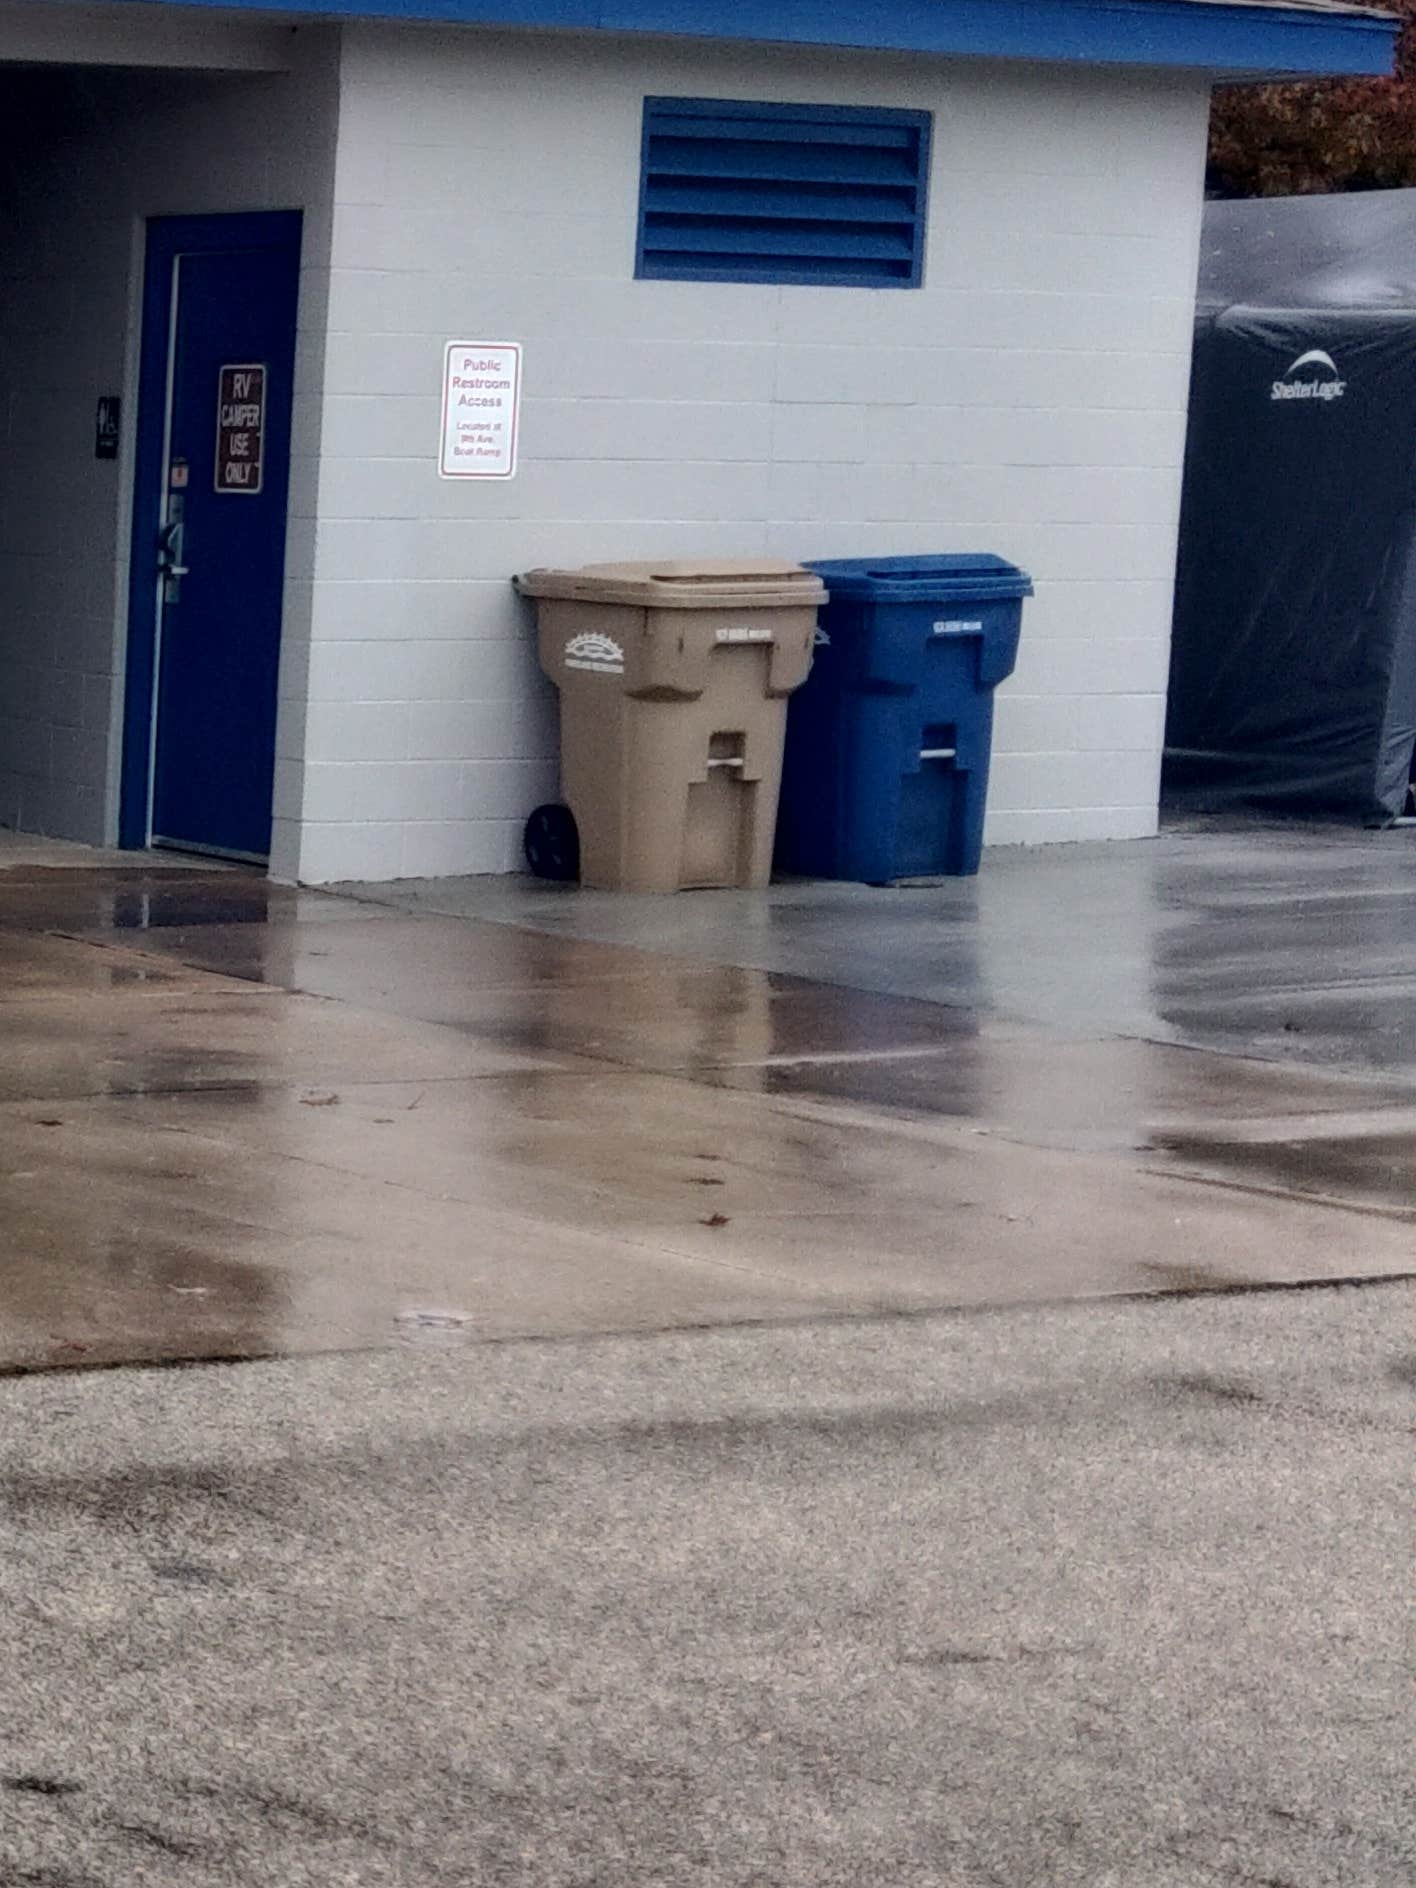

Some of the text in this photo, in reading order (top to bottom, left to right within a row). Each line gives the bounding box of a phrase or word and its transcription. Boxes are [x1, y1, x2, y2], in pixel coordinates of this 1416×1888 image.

[463, 358, 502, 371] Public
[233, 373, 252, 399] RV
[452, 376, 511, 389] Restroom
[1270, 379, 1347, 401] ShelterLogic
[457, 394, 503, 407] Access
[221, 404, 261, 427] CAMPER
[230, 433, 250, 456] USE
[225, 462, 252, 484] ONLY
